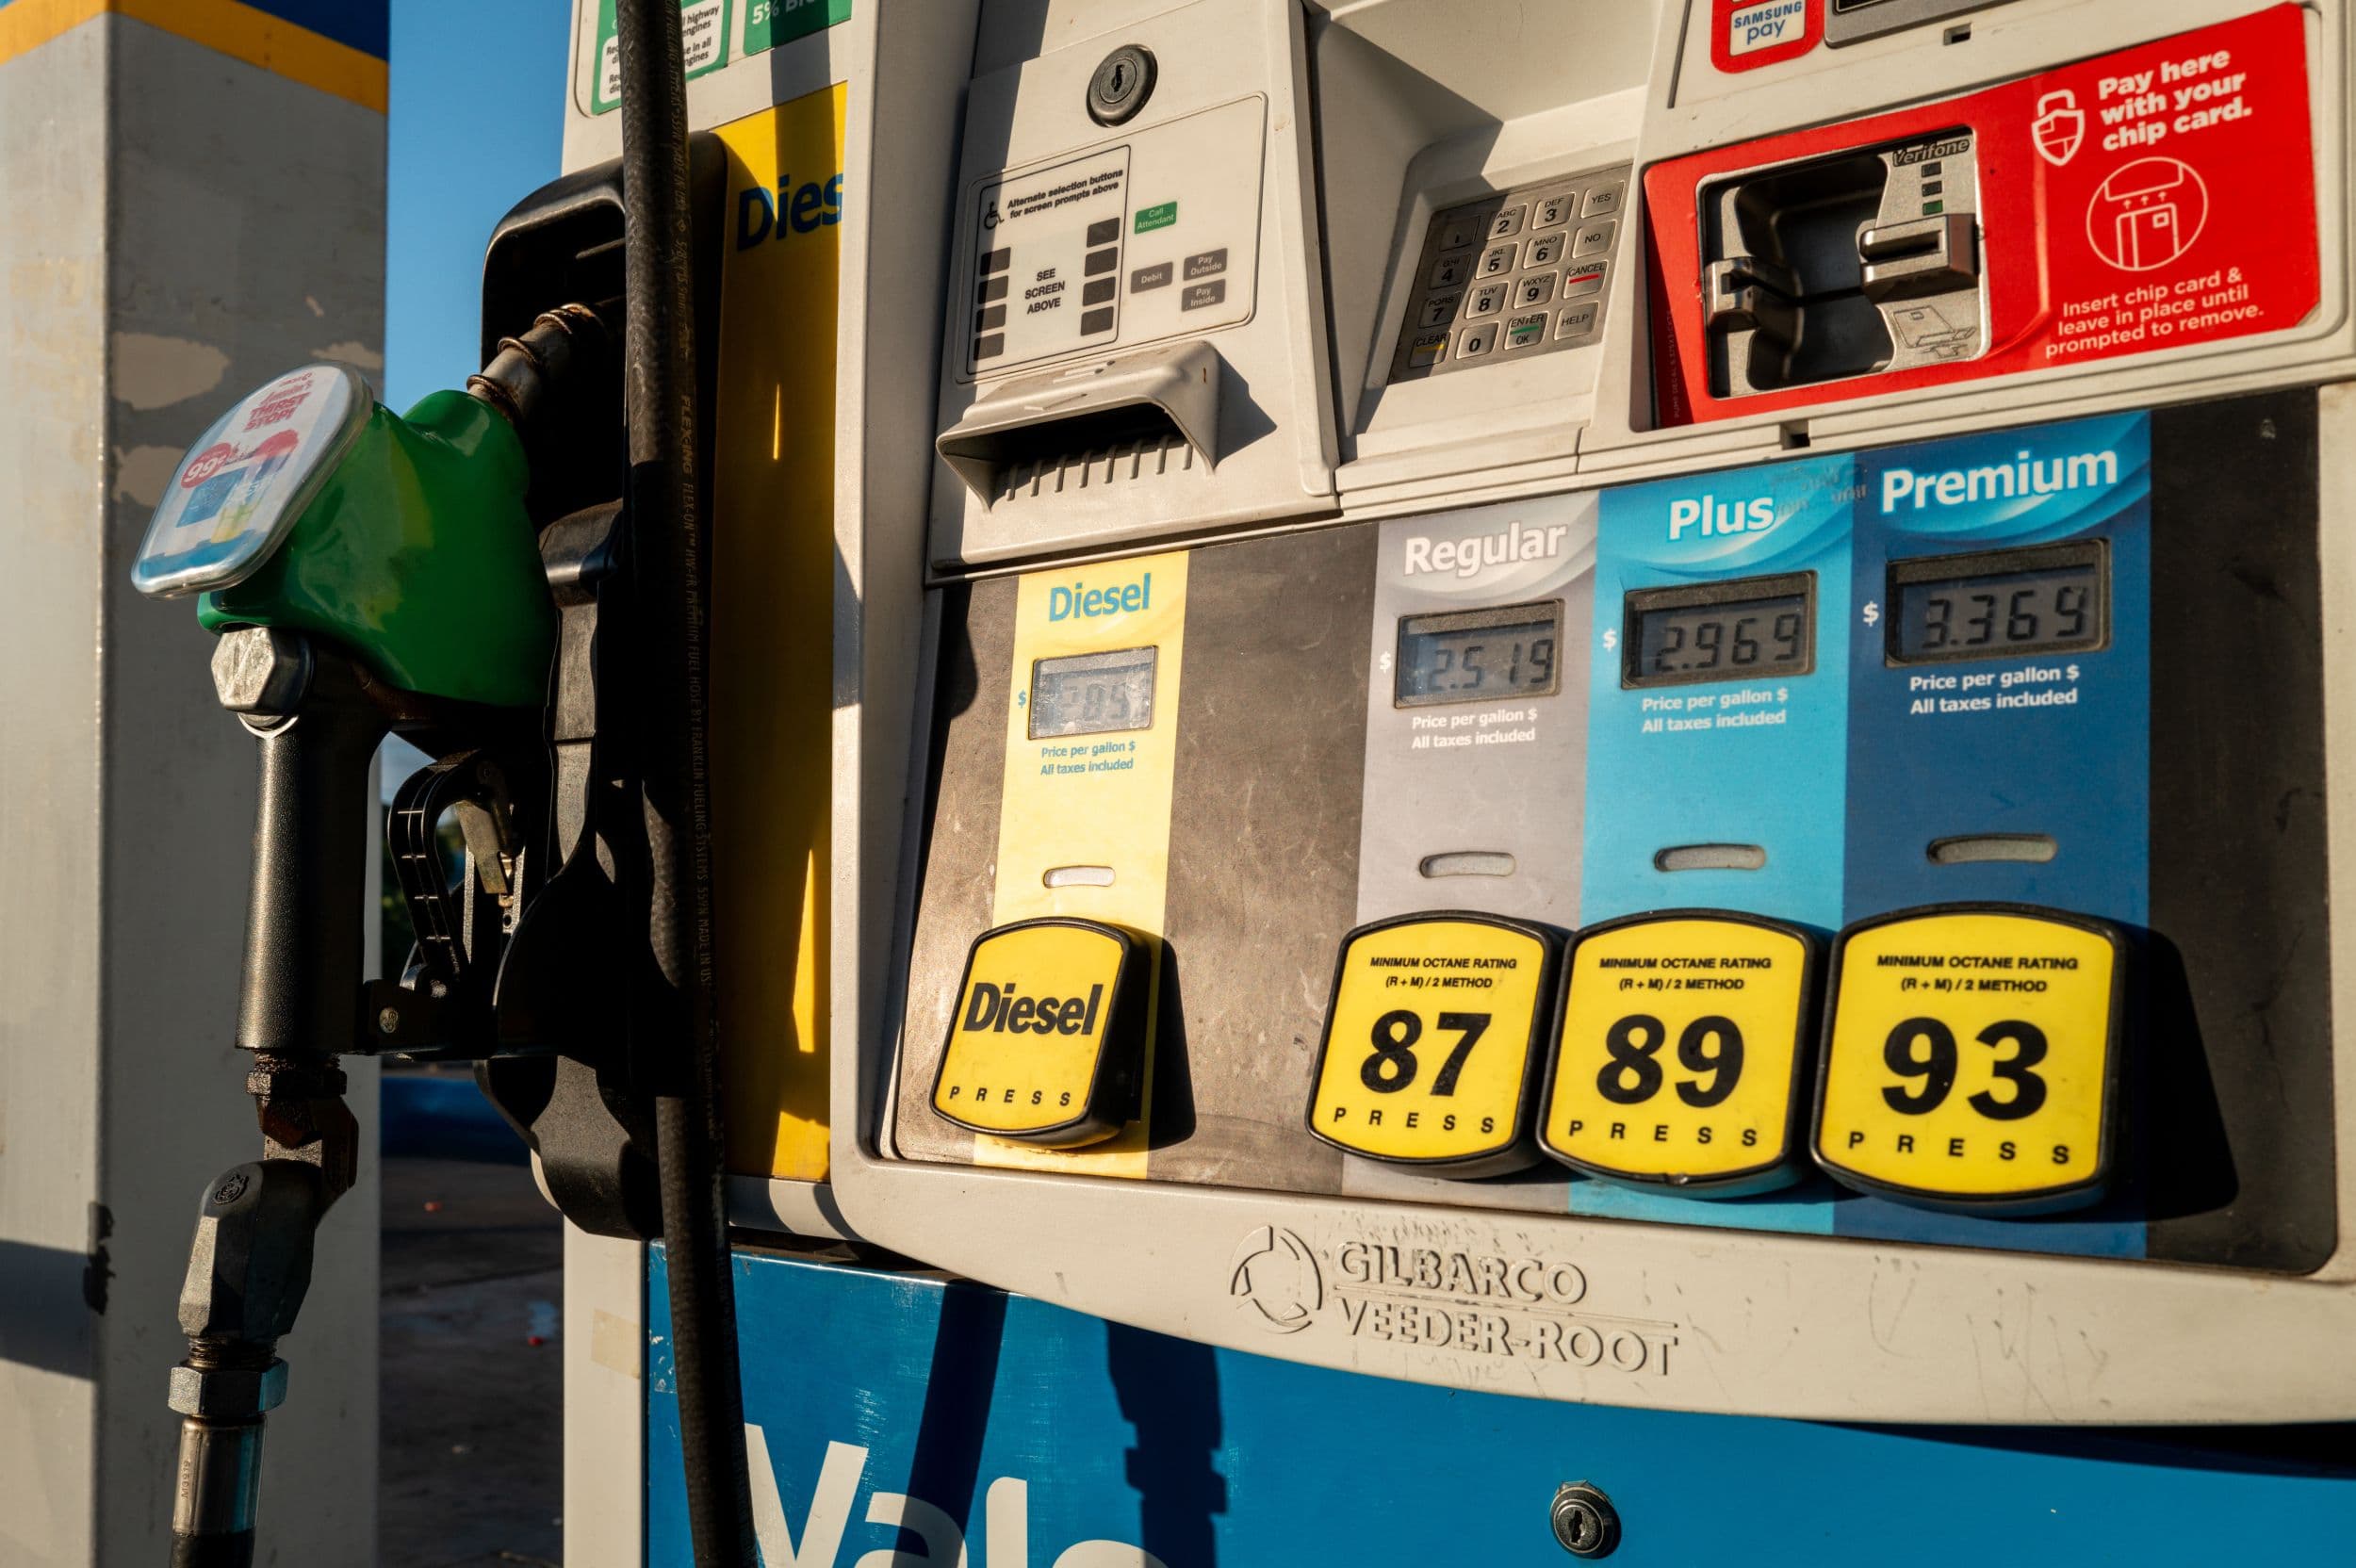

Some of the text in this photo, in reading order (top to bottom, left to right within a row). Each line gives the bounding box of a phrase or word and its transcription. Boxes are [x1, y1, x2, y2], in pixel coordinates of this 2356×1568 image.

[687, 6, 720, 25] highway
[752, 0, 779, 24] 5%
[1734, 1, 1802, 28] SAMSUNG
[1747, 20, 1786, 45] pay
[693, 37, 712, 52] in all
[685, 51, 709, 67] ngines
[2098, 50, 2231, 100] Pay here
[2101, 73, 2247, 125] with your
[2102, 96, 2252, 151] chip card.
[1892, 139, 1970, 167] Verifone
[1007, 169, 1123, 209] Alternate selection buttons
[1010, 181, 1120, 219] for screen prompts above
[1545, 198, 1563, 207] DEF
[1591, 193, 1612, 204] YES
[1148, 207, 1164, 218] Call
[1497, 209, 1516, 219] ABC
[1545, 208, 1557, 222] 3
[1137, 214, 1174, 230] Attendant
[1497, 220, 1509, 234] 2
[1534, 237, 1557, 247] MNO
[1584, 233, 1601, 243] NO
[1198, 254, 1213, 266] Pay
[1489, 249, 1506, 258] JKL
[1536, 248, 1548, 261] 6
[1190, 262, 1222, 275] Outside
[1488, 259, 1500, 271] 5
[1568, 263, 1605, 276] CANCEL
[1037, 269, 1055, 282] SEE
[1141, 272, 1164, 285] Debit
[1442, 269, 1453, 282] 4
[1523, 276, 1550, 287] WXYZ
[1024, 281, 1065, 300] SCREEN
[1196, 286, 1212, 298] Pay
[1480, 286, 1497, 296] TUV
[1527, 287, 1539, 301] 9
[2063, 268, 2242, 318] Insert chip card &
[1026, 297, 1061, 315] ABOVE
[1190, 295, 1216, 307] Inside
[1479, 298, 1490, 312] 8
[1432, 308, 1444, 321] 7
[2058, 284, 2249, 336] leave in place until
[1511, 315, 1544, 328] ENTER
[1562, 314, 1589, 326] HELP
[1416, 333, 1447, 347] CLEAR
[1516, 335, 1529, 344] OK
[2045, 305, 2264, 359] prompted to remove.
[1468, 338, 1481, 351] 0
[1881, 450, 2118, 513] Premium
[1668, 495, 1775, 540] Plus
[1404, 521, 1567, 579] Regular
[1049, 573, 1151, 622] Diesel
[1863, 601, 1879, 627] $
[1922, 585, 2088, 648] 3.369
[1603, 628, 1616, 651] $
[1655, 613, 1801, 672] 2.969
[1380, 651, 1391, 674] $
[1428, 639, 1554, 691] 2.519
[1910, 664, 2080, 691] Price per gallon $
[1018, 690, 1026, 707] $
[1642, 687, 1789, 711] Price per gallon $
[1910, 688, 2078, 714] All taxes included
[1412, 708, 1538, 729] Price per gallon $
[1642, 710, 1787, 733] All taxes included
[1412, 728, 1536, 748] All taxes included
[1041, 741, 1136, 758] Price per gallon $
[1040, 758, 1134, 776] All taxes included
[1370, 957, 1516, 969] MINIMUM OCTANE RATING
[1599, 958, 1771, 969] MINIMUM OCTANE RATING
[1876, 956, 2078, 970] MINIMUM OCTANE RATING
[1385, 977, 1398, 988] (R
[1410, 977, 1423, 988] M)
[1426, 978, 1431, 988] /
[1432, 978, 1439, 988] 2
[1442, 978, 1493, 988] METHOD
[1619, 979, 1633, 990] (R
[1648, 979, 1662, 990] M)
[1666, 979, 1672, 989] /
[1674, 979, 1681, 989] 2
[1685, 979, 1744, 989] METHOD
[1901, 979, 2047, 992] (R + M) / 2 METHOD
[963, 982, 1104, 1035] Diesel
[1360, 1009, 1492, 1097] 87
[1596, 1014, 1744, 1108] 89
[1881, 1016, 2049, 1121] 93
[949, 1086, 1071, 1106] PRESS
[1336, 1240, 1587, 1304] GILBARCO
[1334, 1297, 1679, 1376] VEEDER-ROOT
[744, 1422, 1174, 1568] Val
